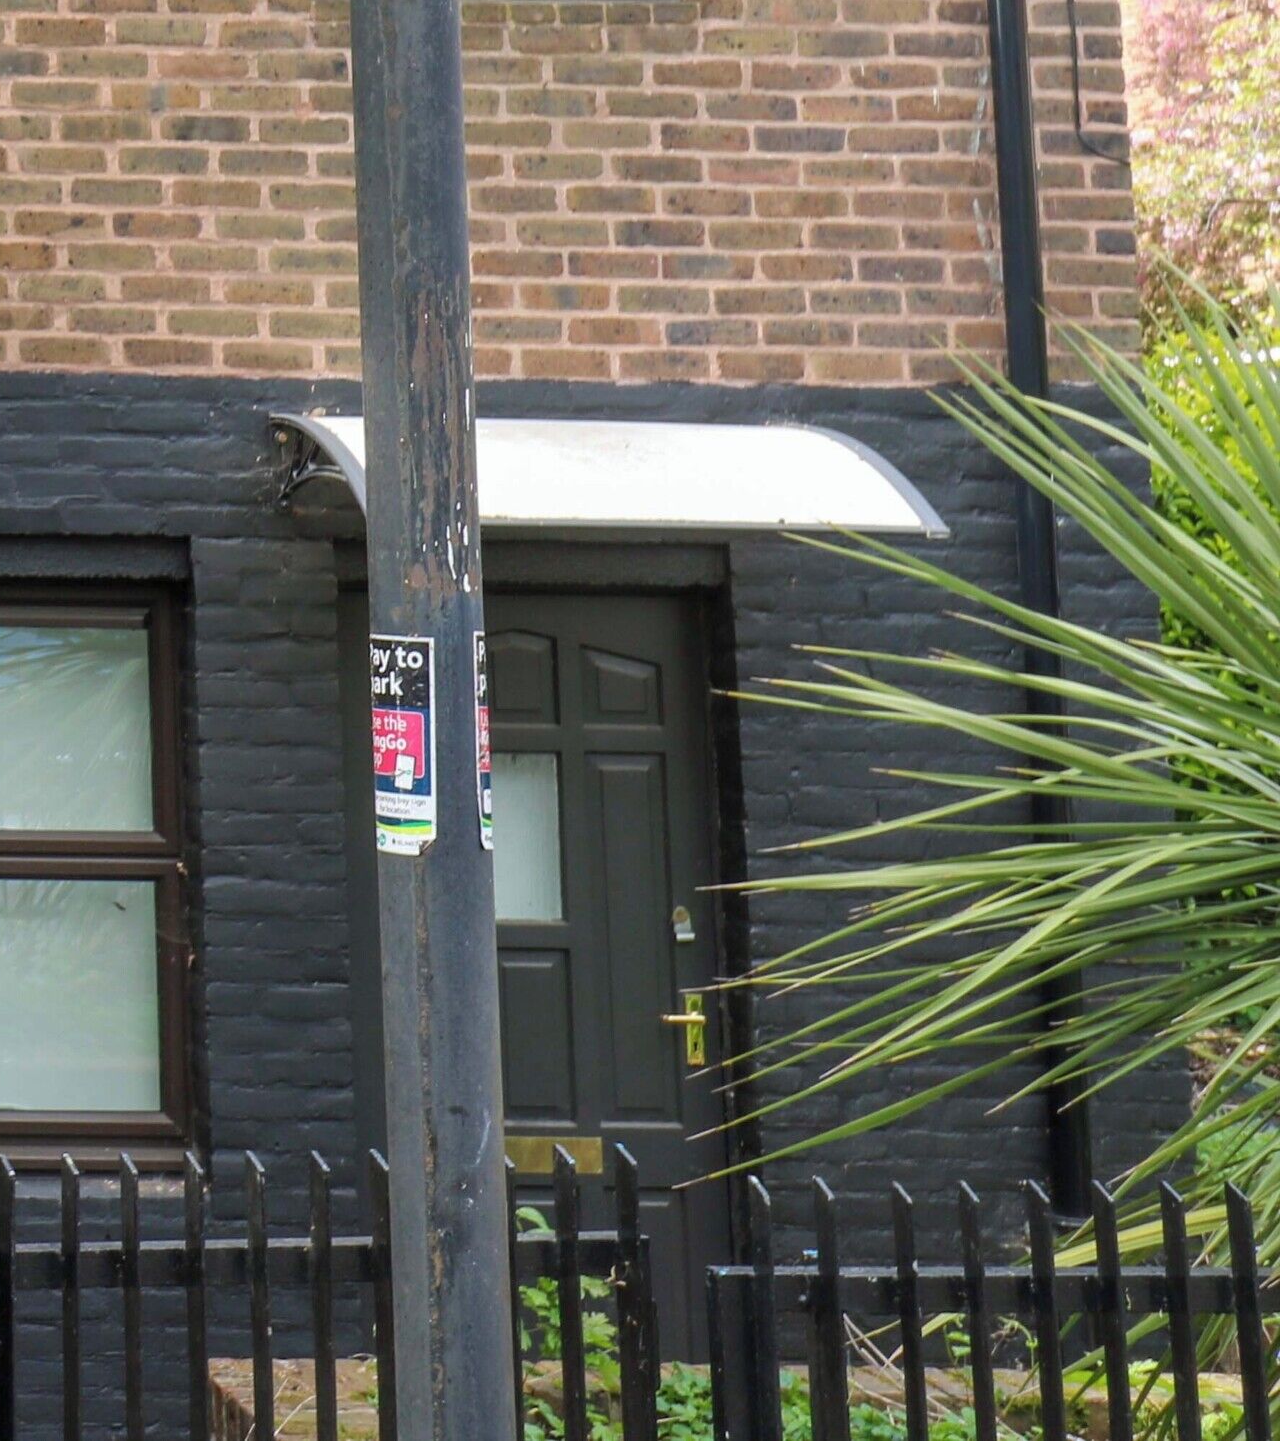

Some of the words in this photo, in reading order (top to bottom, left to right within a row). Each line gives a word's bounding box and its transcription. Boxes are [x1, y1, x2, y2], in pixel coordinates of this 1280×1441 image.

[395, 646, 424, 670] to
[384, 714, 407, 732] the
[373, 731, 407, 753] ingGo
